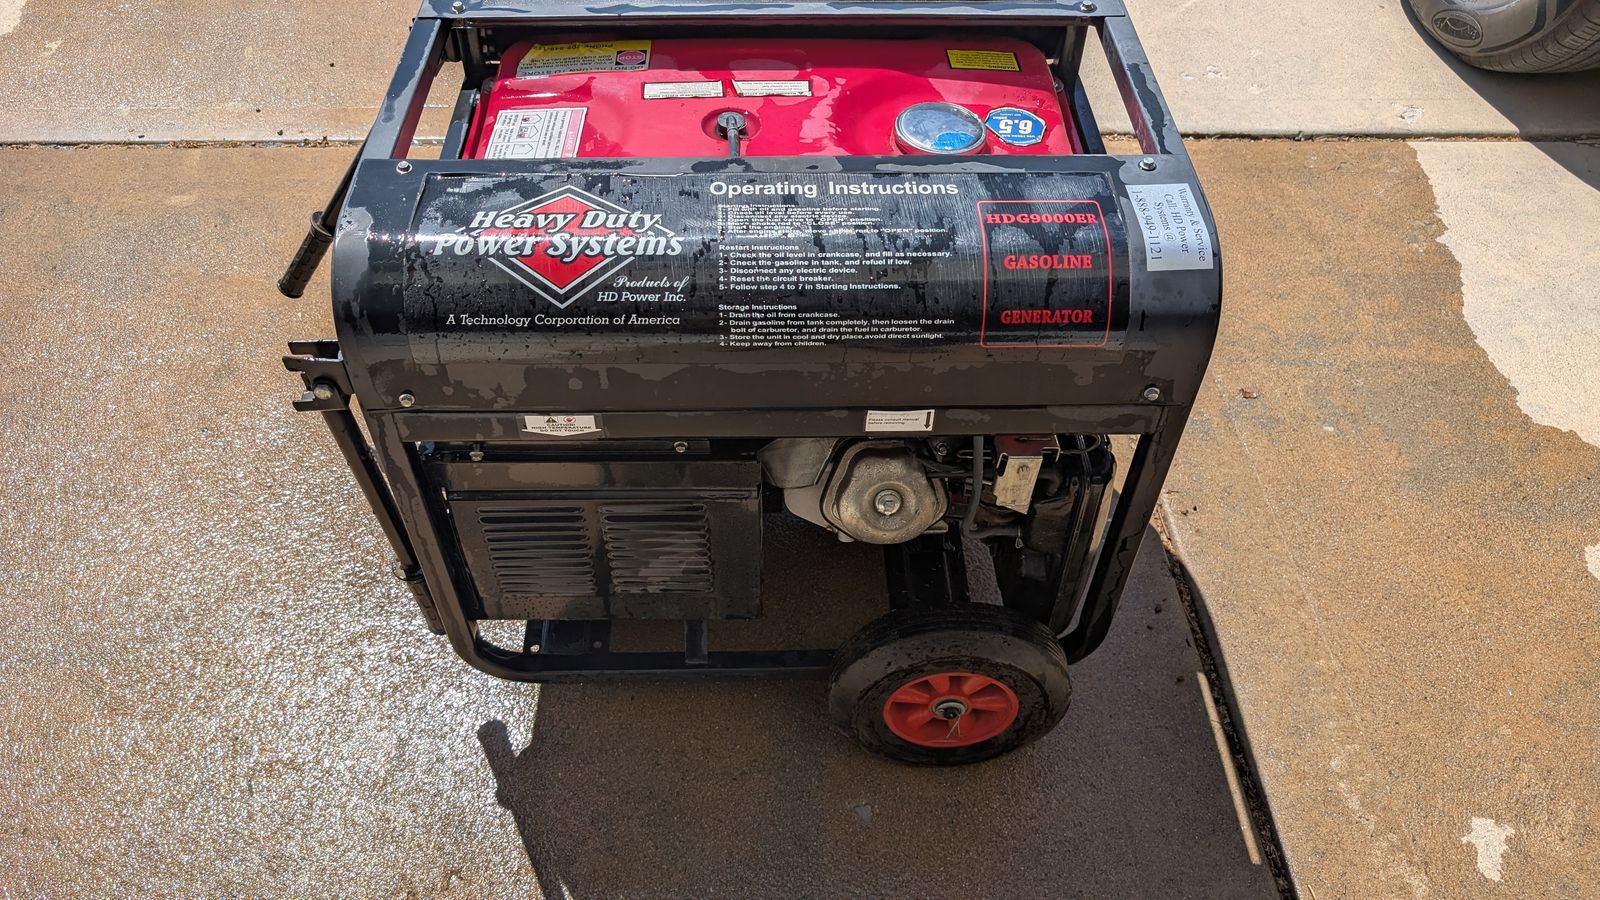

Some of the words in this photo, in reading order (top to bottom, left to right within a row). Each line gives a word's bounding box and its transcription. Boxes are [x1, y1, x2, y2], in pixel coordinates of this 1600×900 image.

[999, 120, 1032, 134] 6.5
[709, 181, 818, 198] Operating
[828, 181, 959, 195] Instructions
[1164, 193, 1178, 210] Call:
[469, 210, 577, 232] Heavy
[581, 209, 662, 232] Duty
[986, 212, 1099, 224] HDG9000ER
[1132, 190, 1163, 260] 1-888-949-1121
[1153, 202, 1172, 231] Systems
[1164, 232, 1176, 242] @
[1171, 212, 1184, 224] HD
[1177, 187, 1194, 219] Warranty
[1194, 228, 1207, 262] Service
[432, 232, 545, 257] Power
[547, 231, 685, 263] Systems
[1176, 226, 1190, 254] Power
[1004, 254, 1094, 270] GASOLINE
[613, 276, 670, 289] Products
[673, 275, 689, 291] of
[597, 291, 619, 302] HD
[622, 291, 661, 302] Power
[664, 291, 687, 302] Inc.
[446, 314, 456, 326] A
[461, 313, 531, 328] Technology
[534, 313, 609, 328] Corporation
[613, 313, 625, 326] of
[628, 313, 680, 326] America
[1001, 309, 1094, 324] GENERATOR
